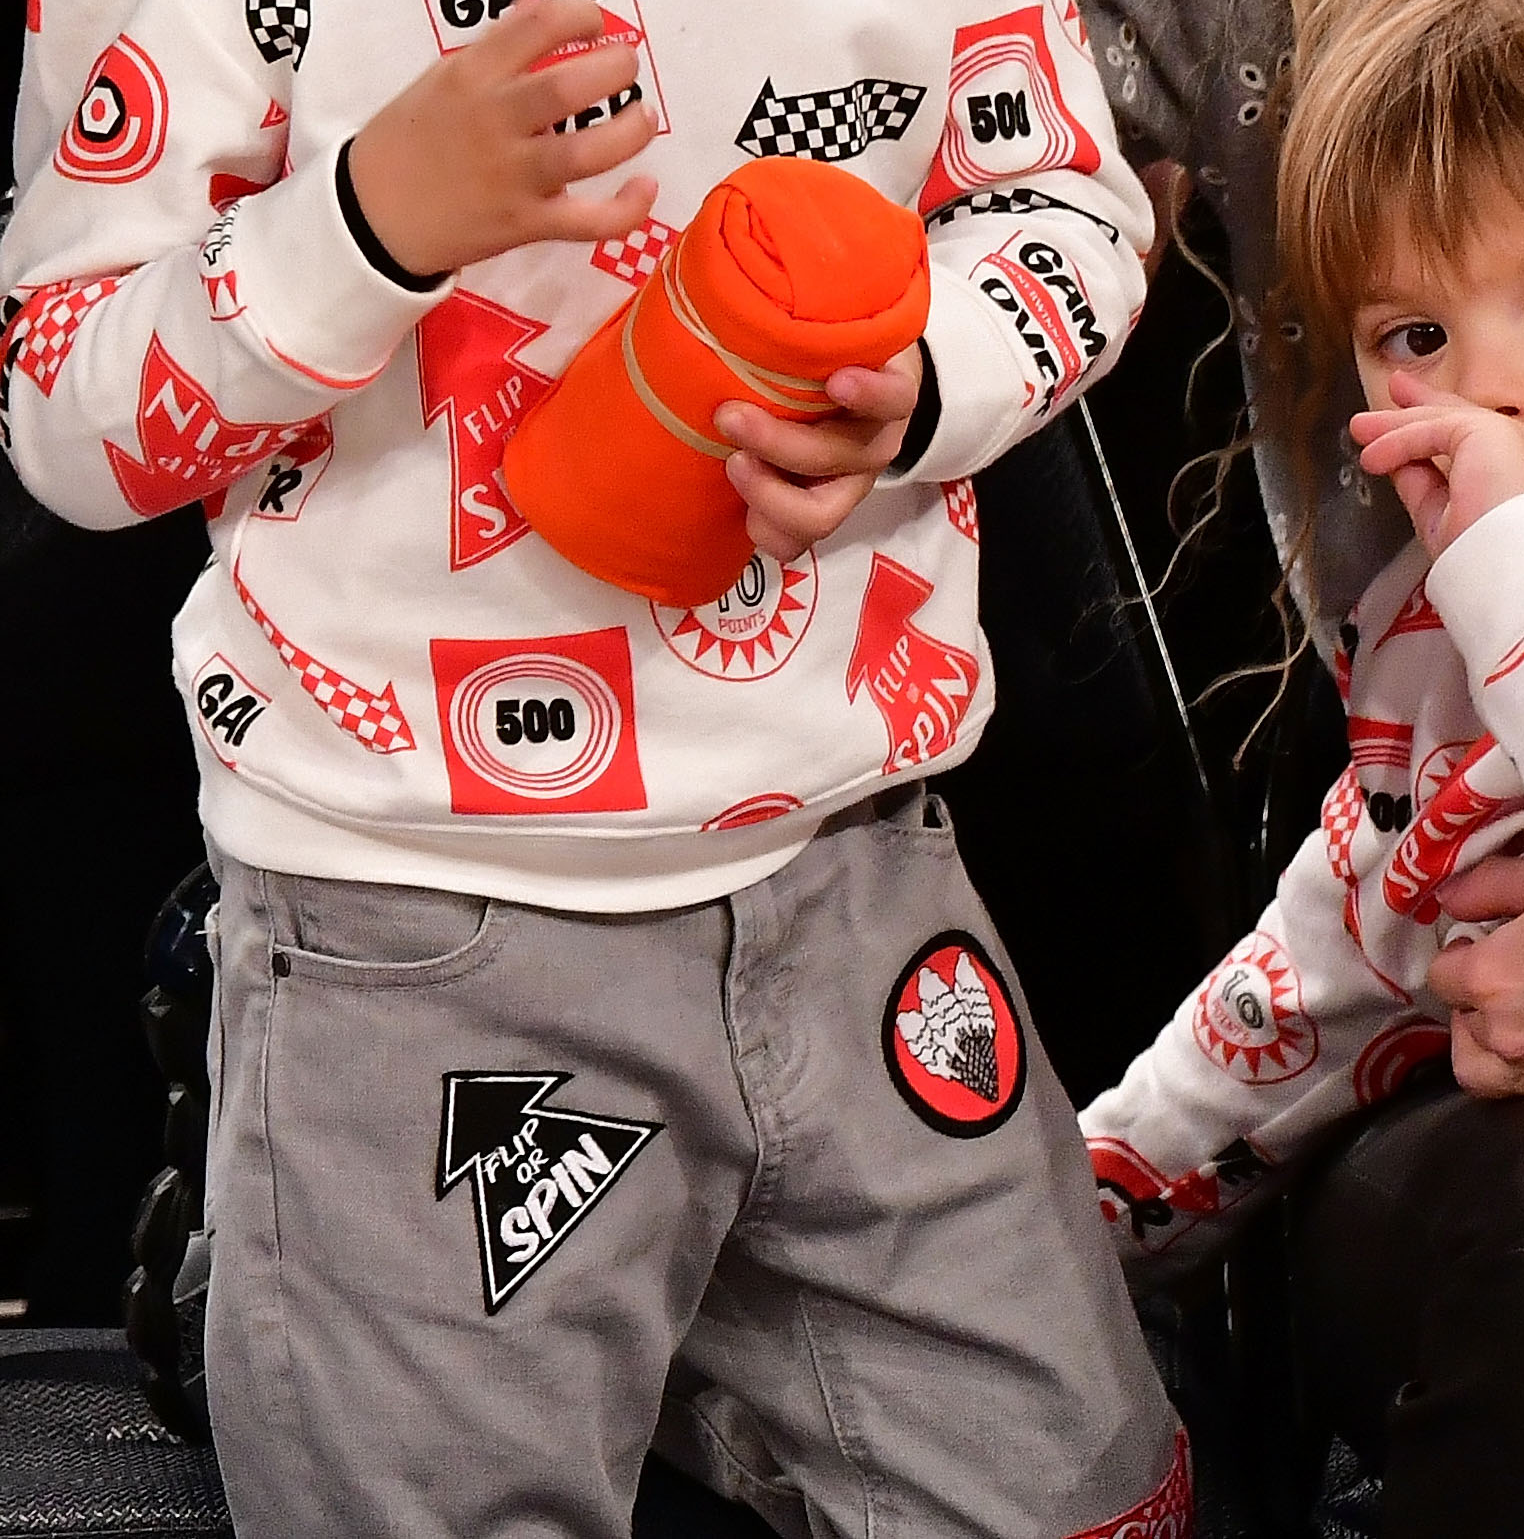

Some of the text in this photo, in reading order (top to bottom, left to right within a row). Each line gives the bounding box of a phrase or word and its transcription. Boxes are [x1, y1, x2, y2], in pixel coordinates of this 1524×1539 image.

[1018, 242, 1108, 387] GAM
[463, 374, 524, 446] FLIP
[718, 608, 767, 634] POINTS
[873, 634, 911, 705] FLIP
[495, 698, 576, 745] 500
[892, 653, 969, 769] SPIN
[1221, 969, 1264, 1030] 10
[483, 1117, 538, 1185] FLIP
[516, 1148, 550, 1184] OR
[500, 1132, 613, 1263] SPIN
